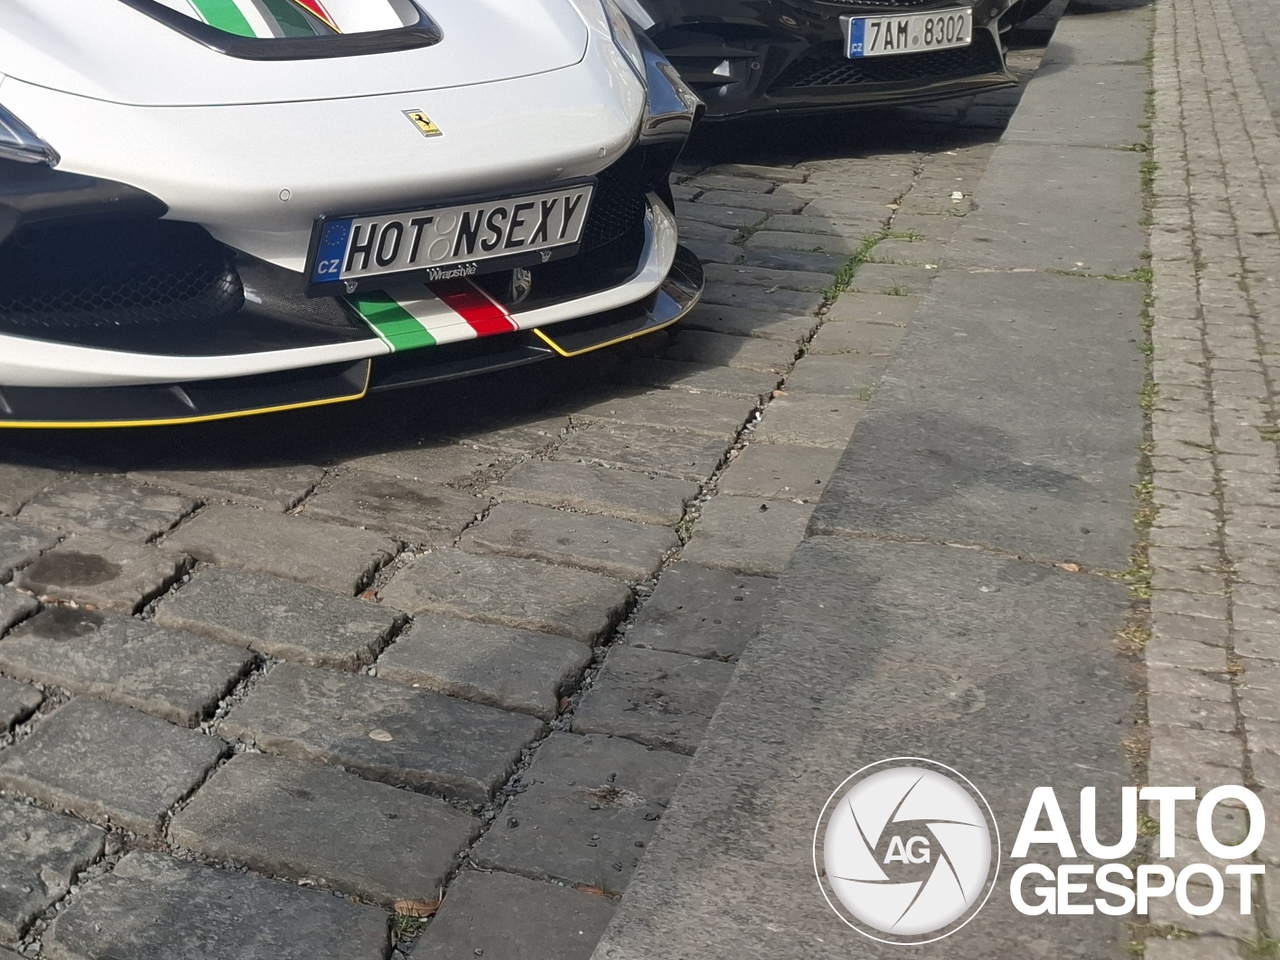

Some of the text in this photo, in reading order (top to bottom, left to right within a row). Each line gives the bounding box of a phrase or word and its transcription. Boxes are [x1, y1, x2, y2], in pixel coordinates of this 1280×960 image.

[870, 15, 964, 51] 7AM 8302
[851, 43, 863, 52] CZ
[344, 193, 583, 272] HOT NSEXY
[318, 259, 340, 274] CZ
[426, 262, 478, 281] Wrapstyle
